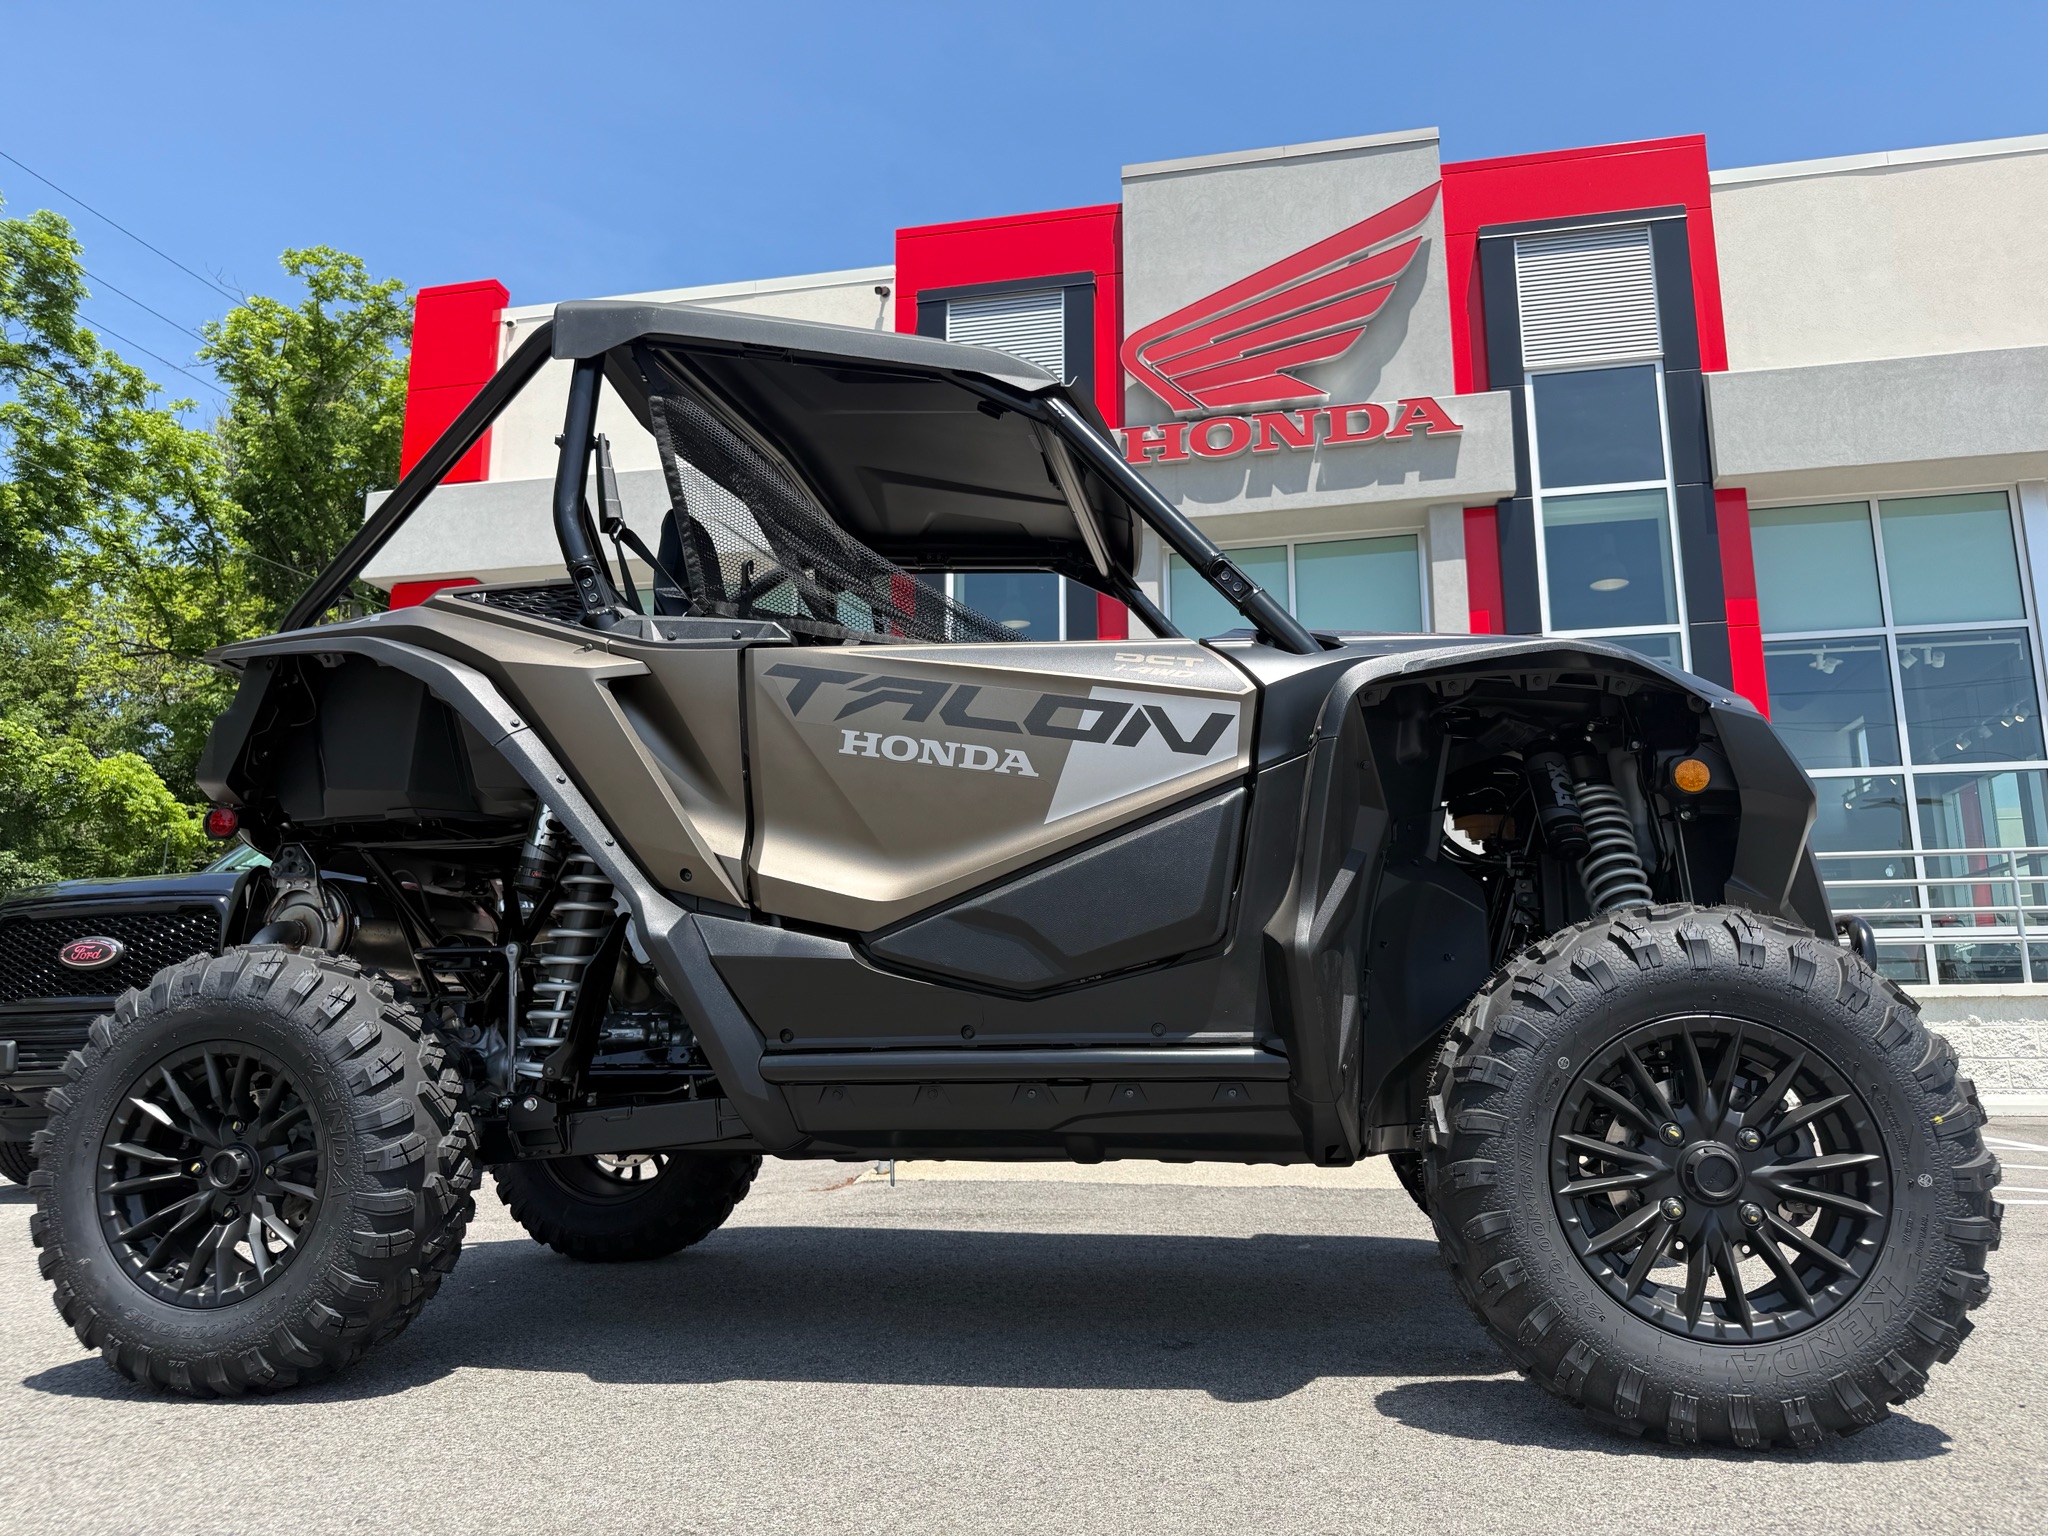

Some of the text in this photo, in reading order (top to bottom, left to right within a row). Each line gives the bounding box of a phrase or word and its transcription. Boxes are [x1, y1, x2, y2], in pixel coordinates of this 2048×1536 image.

[1120, 396, 1464, 465] HONDA
[1114, 652, 1204, 667] DCT
[762, 663, 1236, 756] TALON
[838, 729, 1040, 777] HONDA
[1545, 761, 1578, 807] FOX
[71, 945, 103, 960] Ford
[302, 1052, 348, 1198] KENDA
[1731, 1276, 1905, 1383] KENDA
